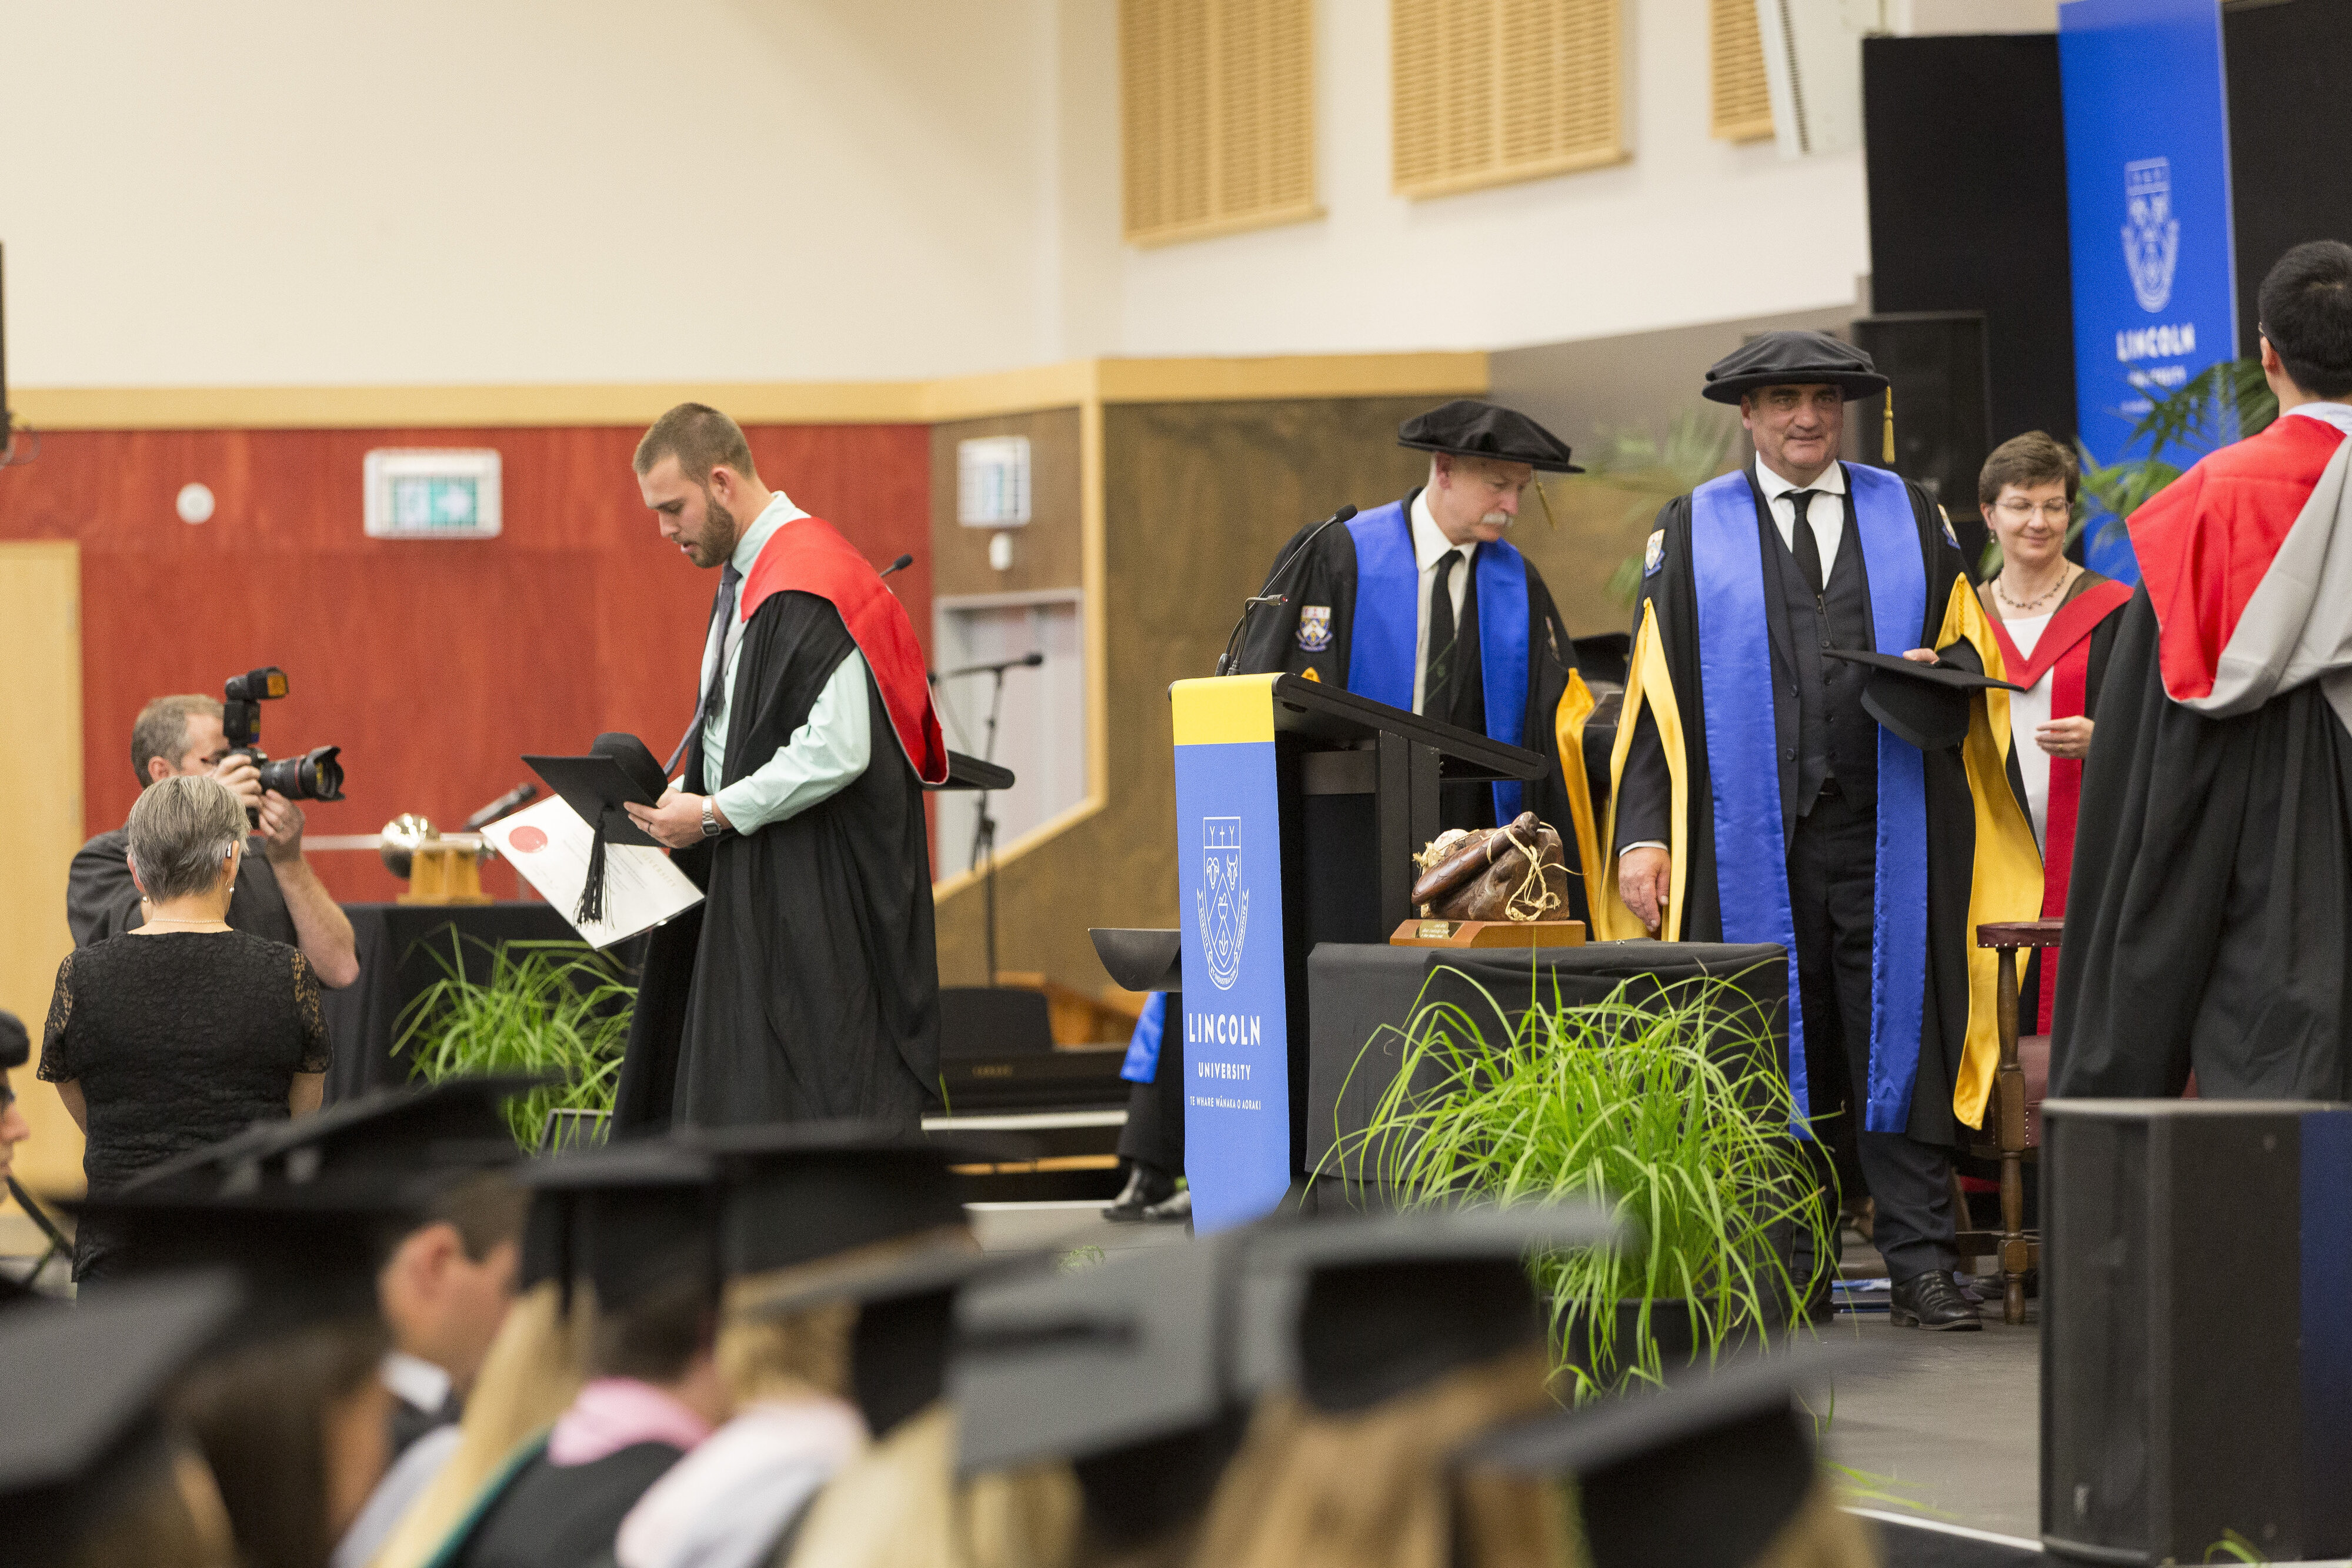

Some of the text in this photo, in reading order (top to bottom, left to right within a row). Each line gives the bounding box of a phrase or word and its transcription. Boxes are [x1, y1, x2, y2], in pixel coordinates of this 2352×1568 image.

[2116, 323, 2196, 362] LINCOLN
[1189, 1013, 1260, 1046] LINCOLN
[1198, 1062, 1251, 1080] UNIVERSITY
[1190, 1096, 1195, 1106] TE
[1196, 1096, 1214, 1107] WHARE
[1237, 1099, 1241, 1109] O
[1242, 1099, 1261, 1110] AORAKI
